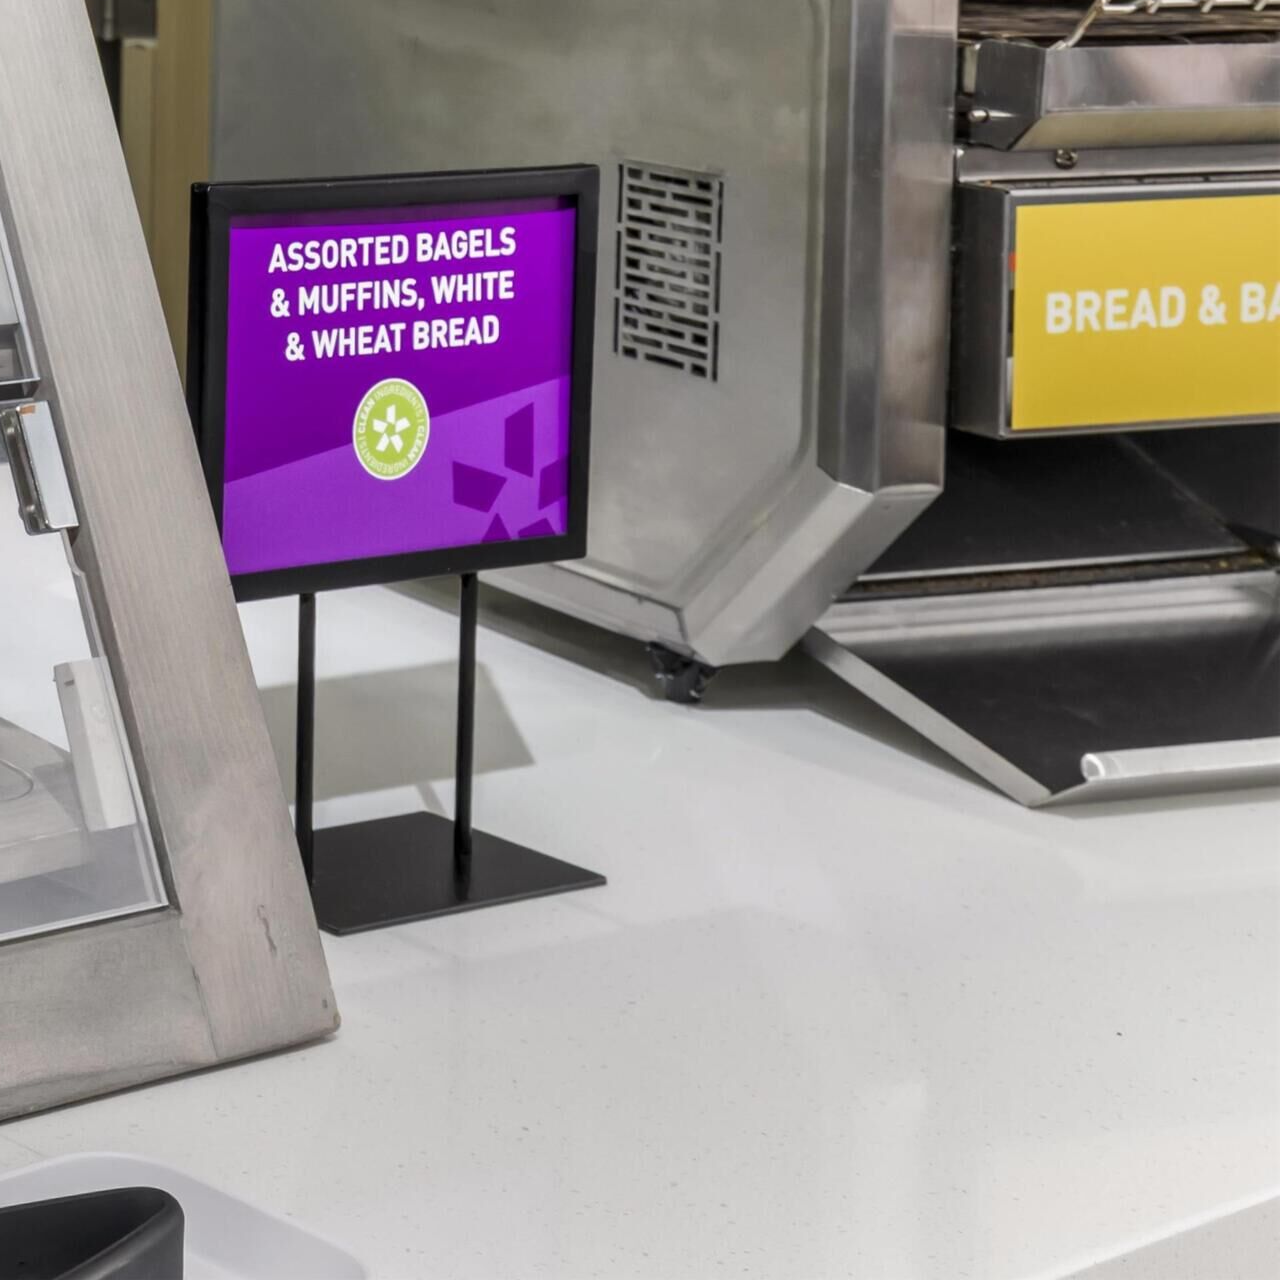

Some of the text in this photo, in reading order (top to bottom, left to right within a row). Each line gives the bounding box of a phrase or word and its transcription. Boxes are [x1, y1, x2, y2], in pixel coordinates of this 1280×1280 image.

[268, 227, 517, 273] ASSORTED BAGELS
[270, 270, 515, 318] & MUFFINS, WHITE
[1045, 286, 1186, 334] BREAD
[1198, 284, 1227, 326] &
[284, 315, 500, 361] & WHEAT BREAD
[357, 398, 375, 433] CLEAN
